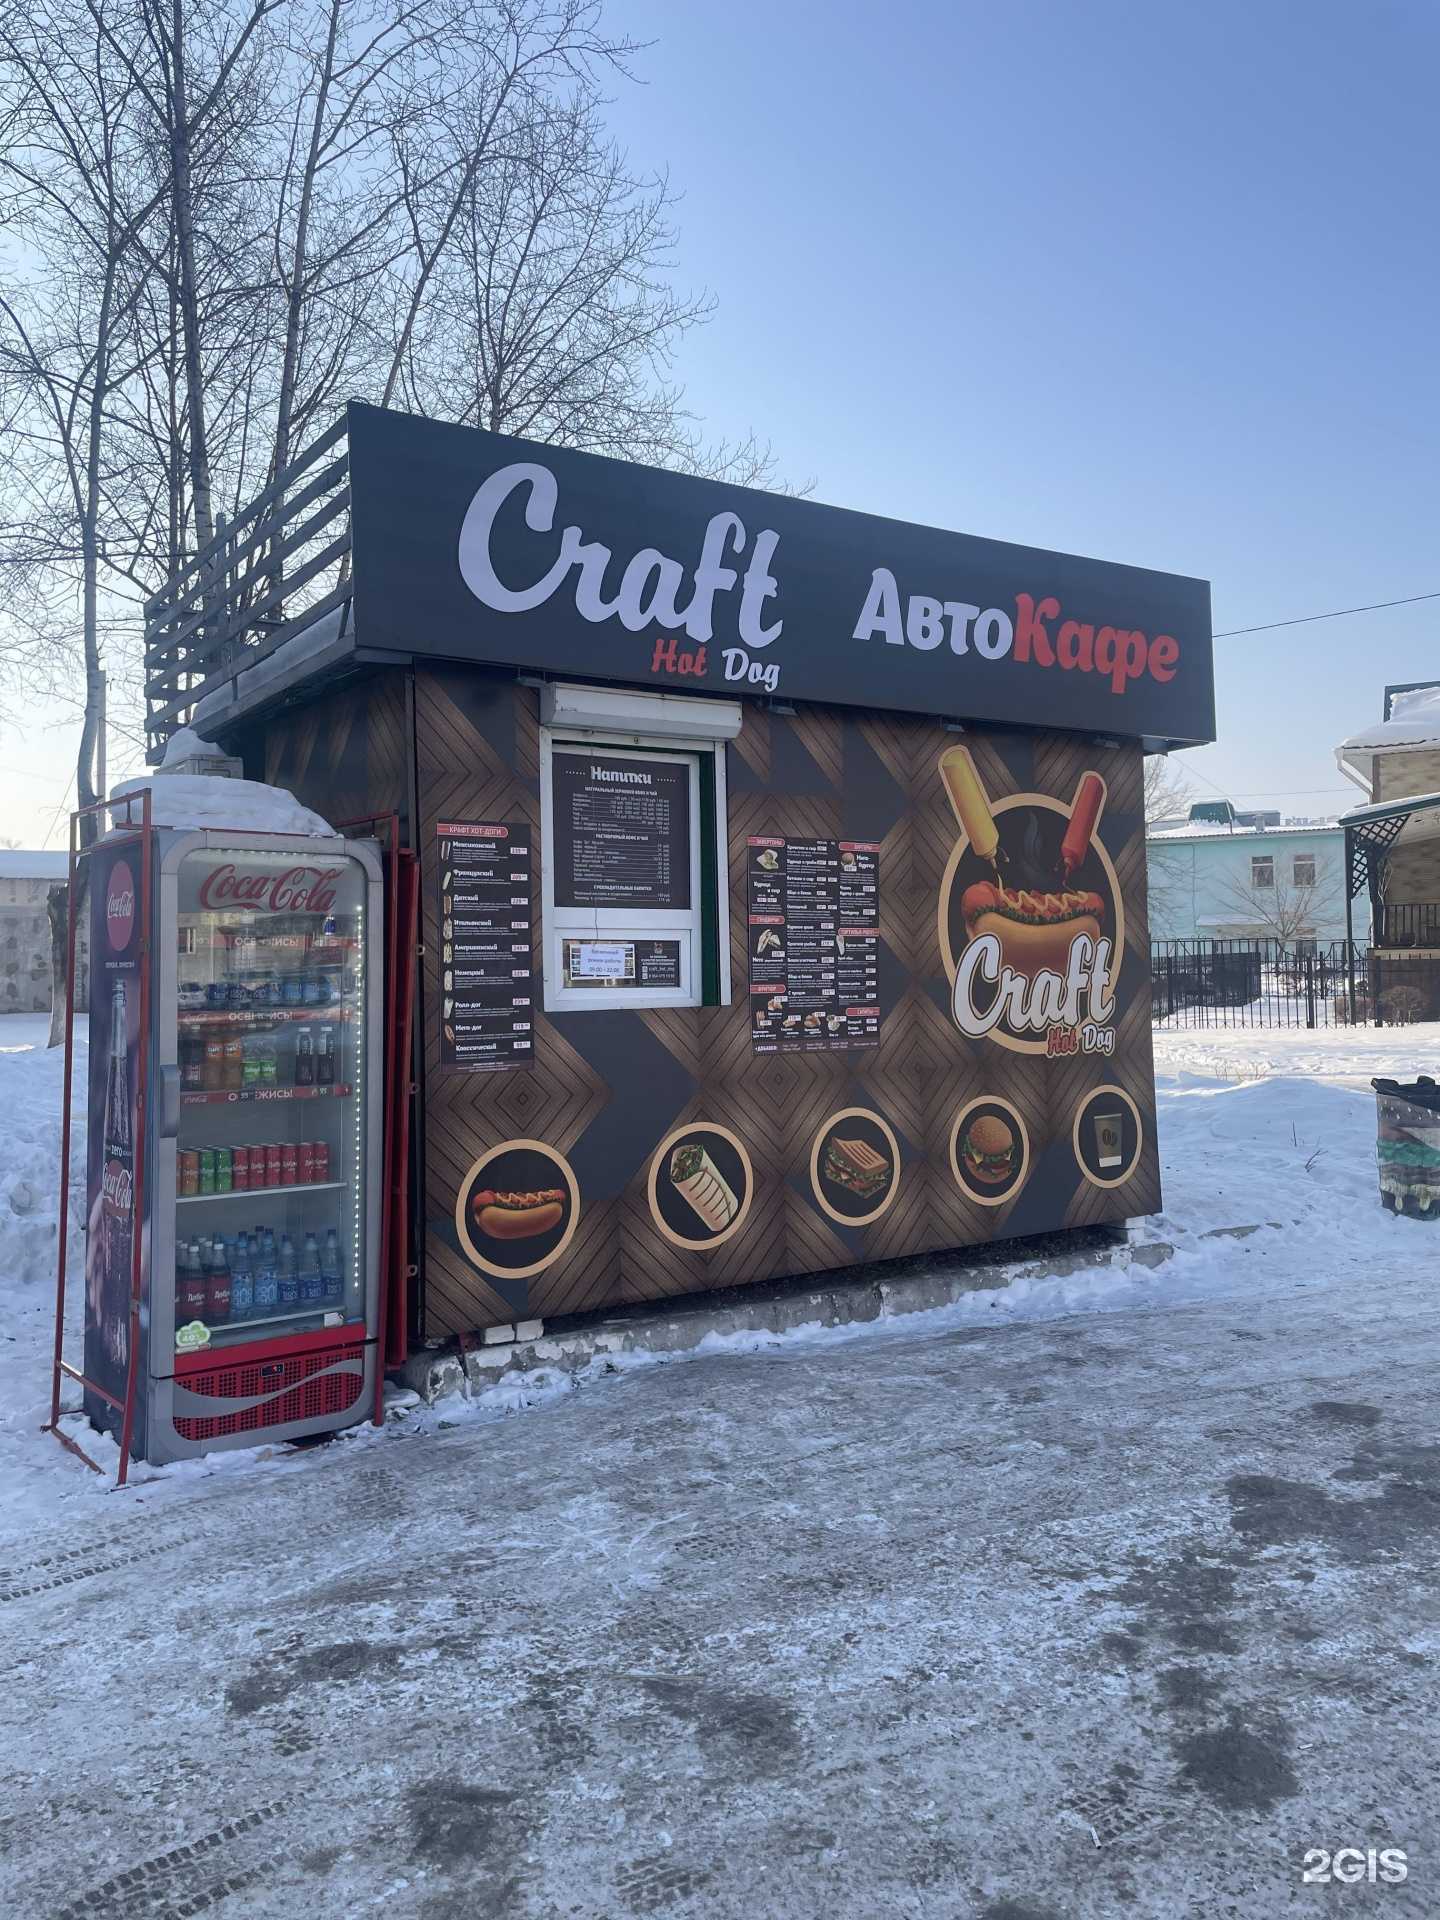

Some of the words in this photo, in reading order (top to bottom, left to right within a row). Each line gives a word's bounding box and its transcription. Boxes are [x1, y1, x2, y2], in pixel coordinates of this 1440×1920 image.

[458, 463, 783, 649] Craft
[852, 567, 1181, 695] АвтоКафе
[651, 638, 707, 676] Hot
[722, 648, 781, 694] Dog
[590, 766, 652, 785] Напитки
[199, 864, 344, 913] Coca-Cola
[954, 935, 1115, 1037] Craft
[1046, 1025, 1078, 1057] Hot
[1082, 1024, 1115, 1056] Dog
[111, 1145, 123, 1157] zero
